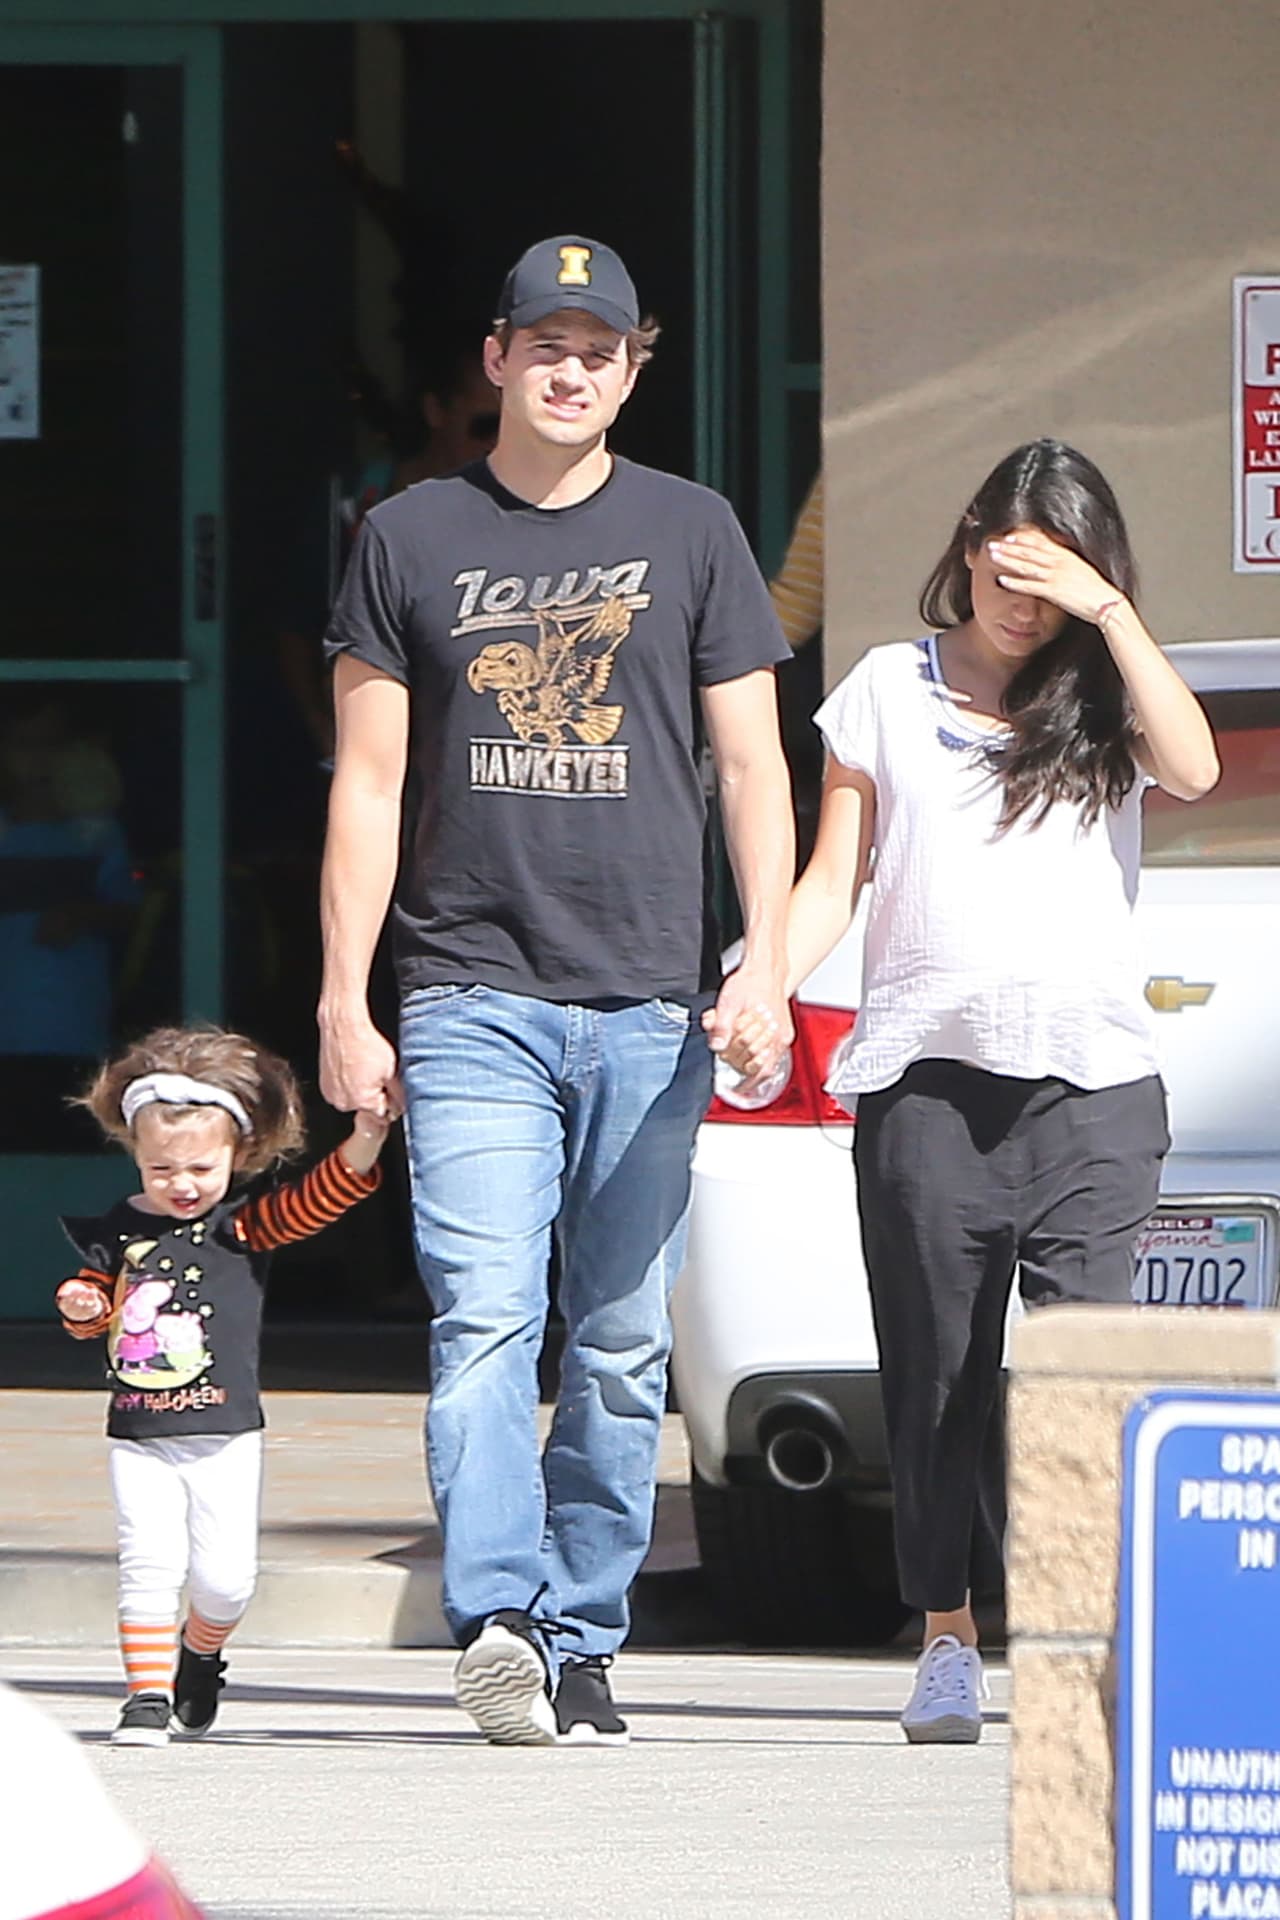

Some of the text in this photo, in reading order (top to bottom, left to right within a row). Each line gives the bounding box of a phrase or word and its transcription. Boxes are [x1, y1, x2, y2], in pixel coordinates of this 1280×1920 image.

[559, 245, 591, 287] I
[453, 559, 650, 620] Iowa
[469, 744, 629, 793] HAWKEYES
[1221, 1434, 1280, 1475] SPA
[1239, 1527, 1277, 1569] IN
[1156, 1790, 1186, 1832] IN
[1176, 1835, 1235, 1877] NOT
